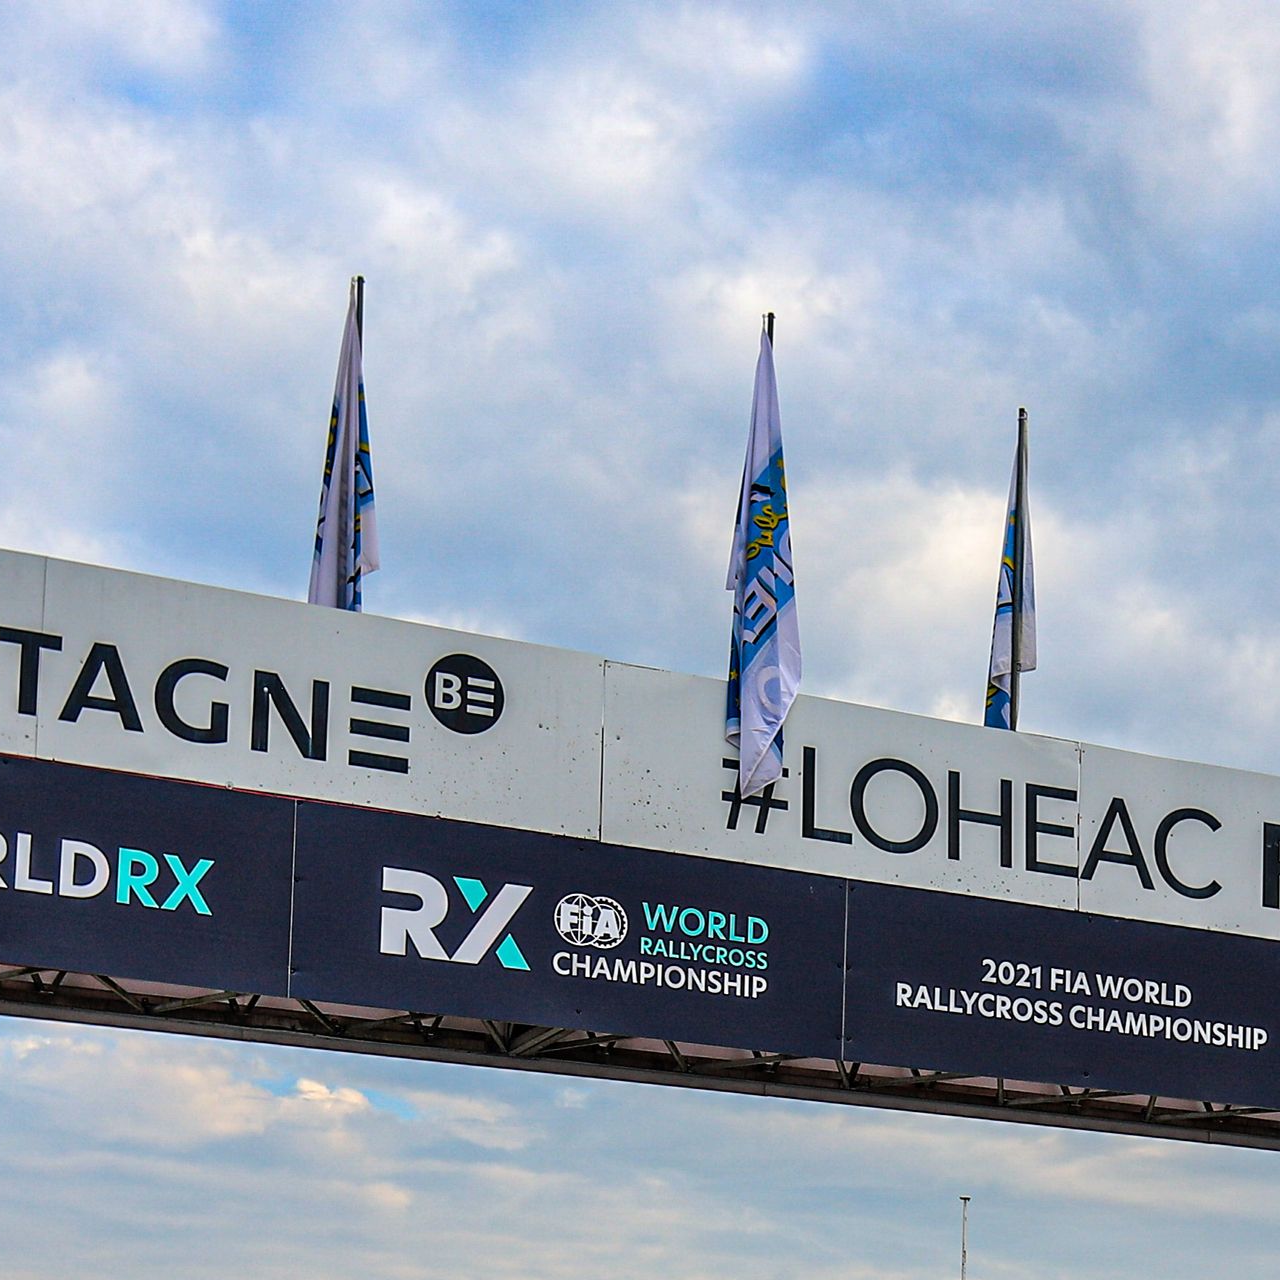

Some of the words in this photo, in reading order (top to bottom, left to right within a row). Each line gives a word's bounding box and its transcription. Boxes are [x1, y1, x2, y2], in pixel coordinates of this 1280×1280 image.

[721, 745, 1222, 901] #LOHEAC
[380, 866, 534, 971] RX
[642, 901, 769, 945] WORLD
[552, 951, 768, 999] CHAMPIONSHIP
[640, 936, 768, 970] RALLYCROSS
[981, 957, 1042, 990] 2021
[1050, 967, 1091, 996] FIA
[1096, 974, 1192, 1008] WORLD
[895, 982, 1063, 1026] RALLYCROSS
[1069, 1005, 1268, 1051] CHAMPIONSHIP
